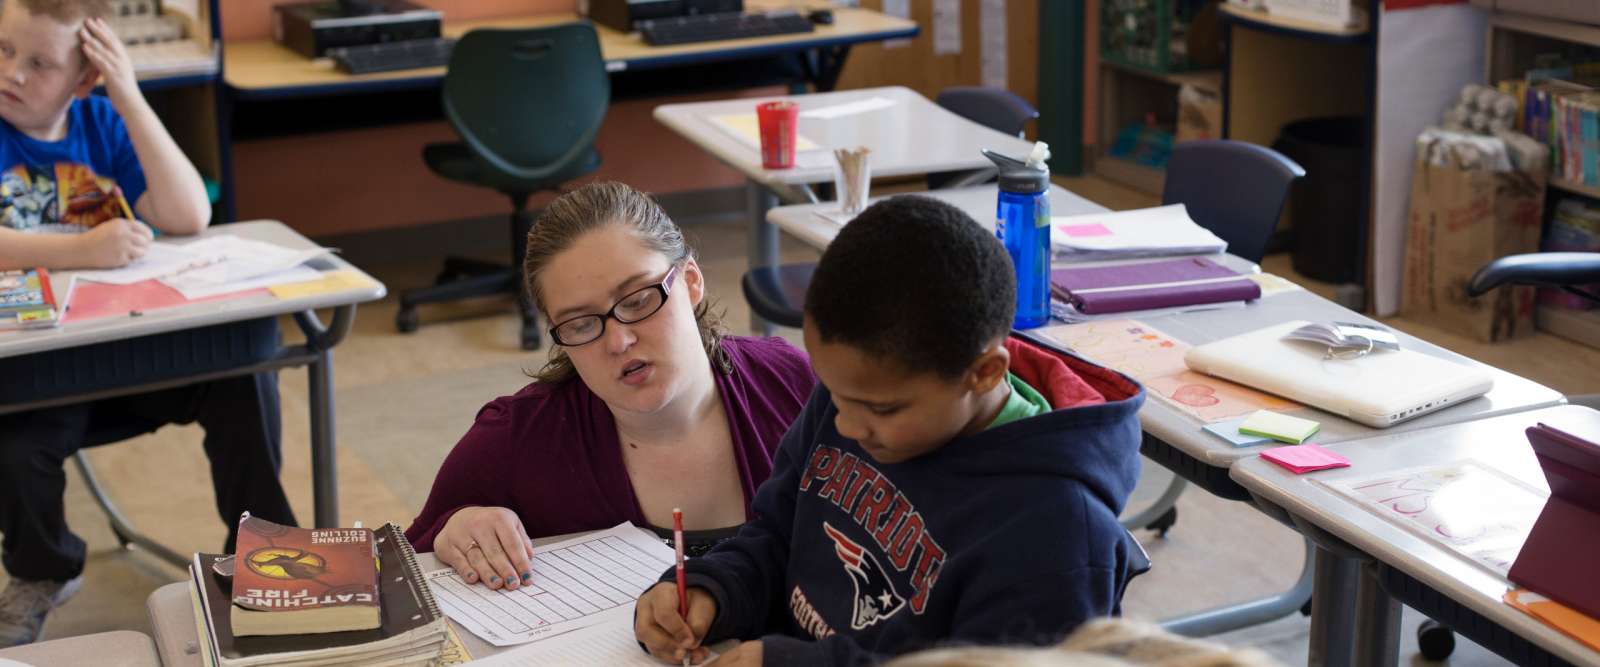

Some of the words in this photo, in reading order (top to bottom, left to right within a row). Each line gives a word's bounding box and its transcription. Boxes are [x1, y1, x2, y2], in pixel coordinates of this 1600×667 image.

[311, 530, 367, 538] COLLINS
[311, 536, 367, 544] SUZANNE
[246, 589, 308, 598] FIRE
[232, 593, 372, 608] CATCHING
